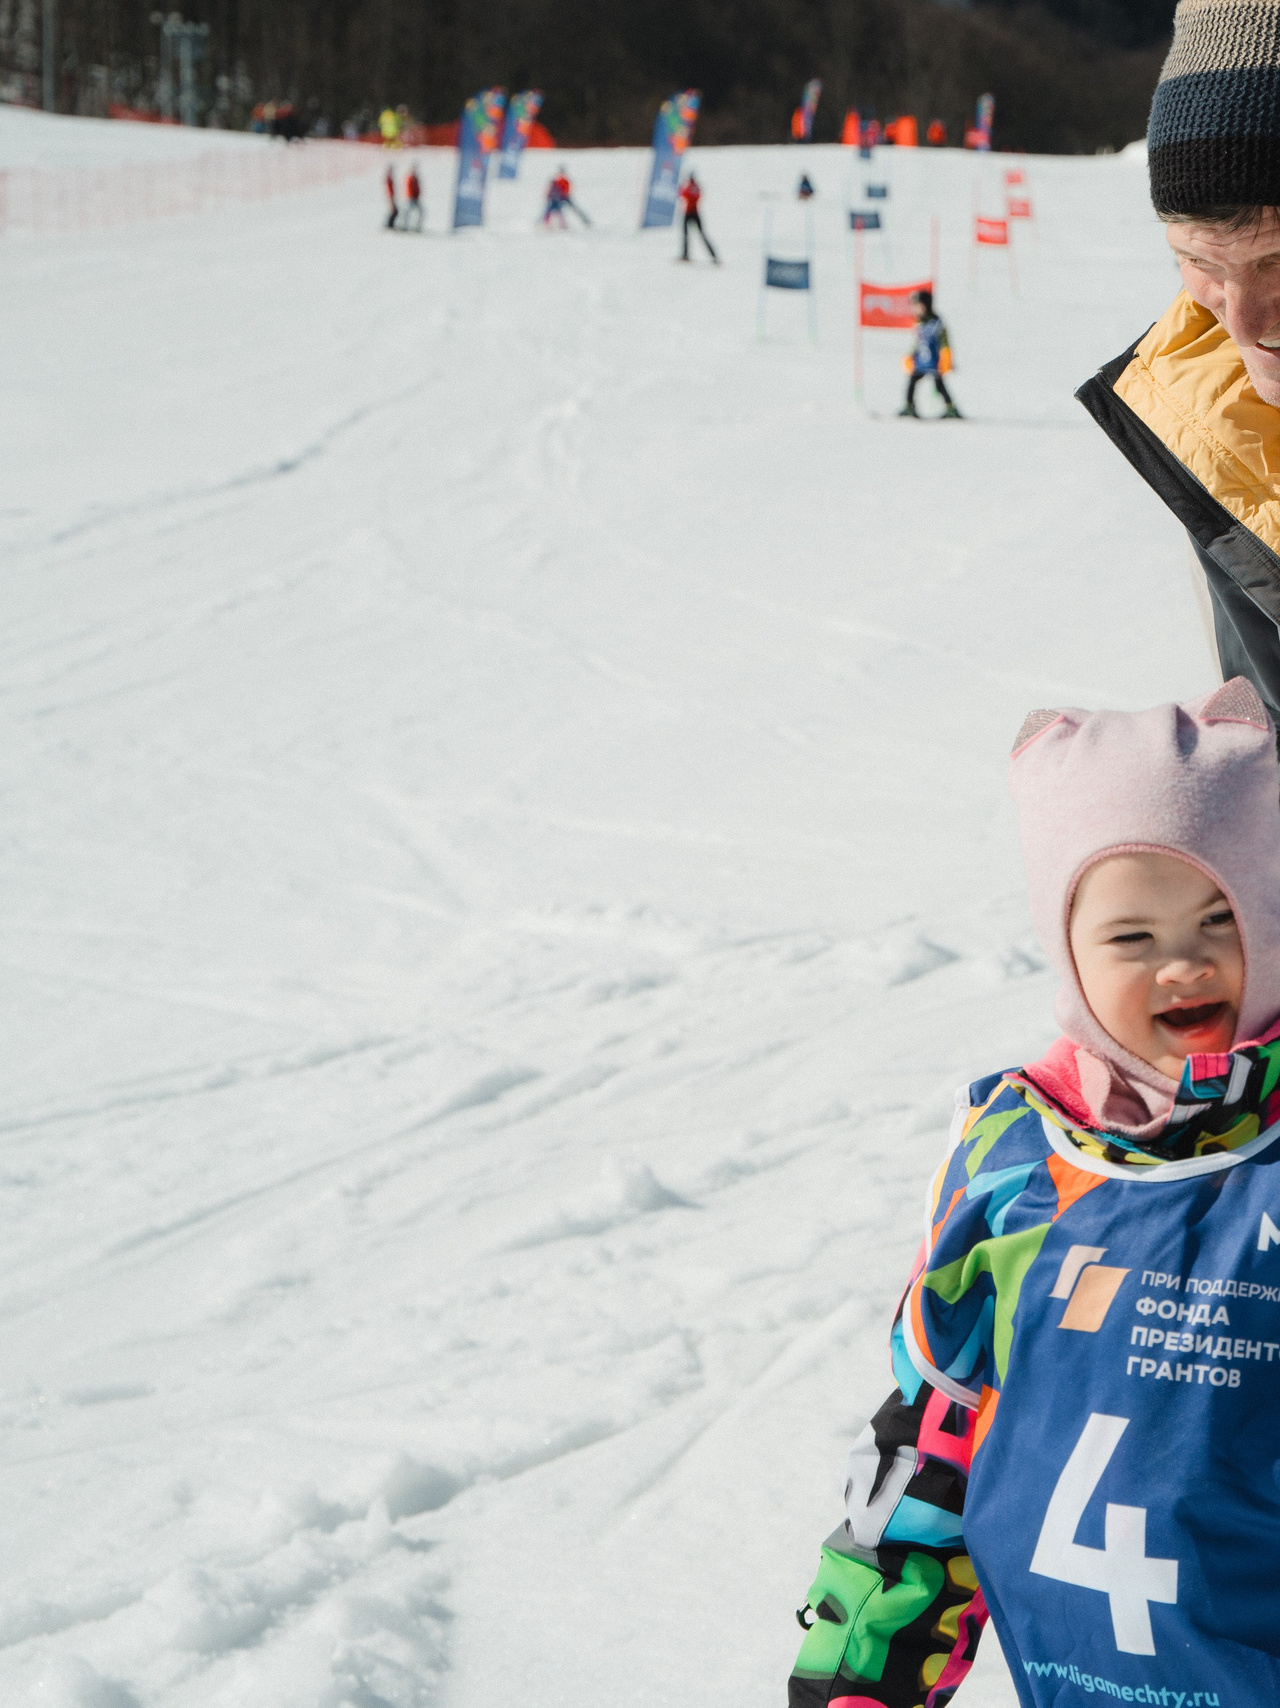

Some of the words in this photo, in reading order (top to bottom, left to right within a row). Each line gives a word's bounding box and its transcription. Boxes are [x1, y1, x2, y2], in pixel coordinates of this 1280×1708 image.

[1141, 1270, 1181, 1291] ПРИ
[1135, 1296, 1230, 1326] ФОНДА
[1126, 1357, 1241, 1388] ГРАНТОВ
[1029, 1412, 1179, 1657] 4
